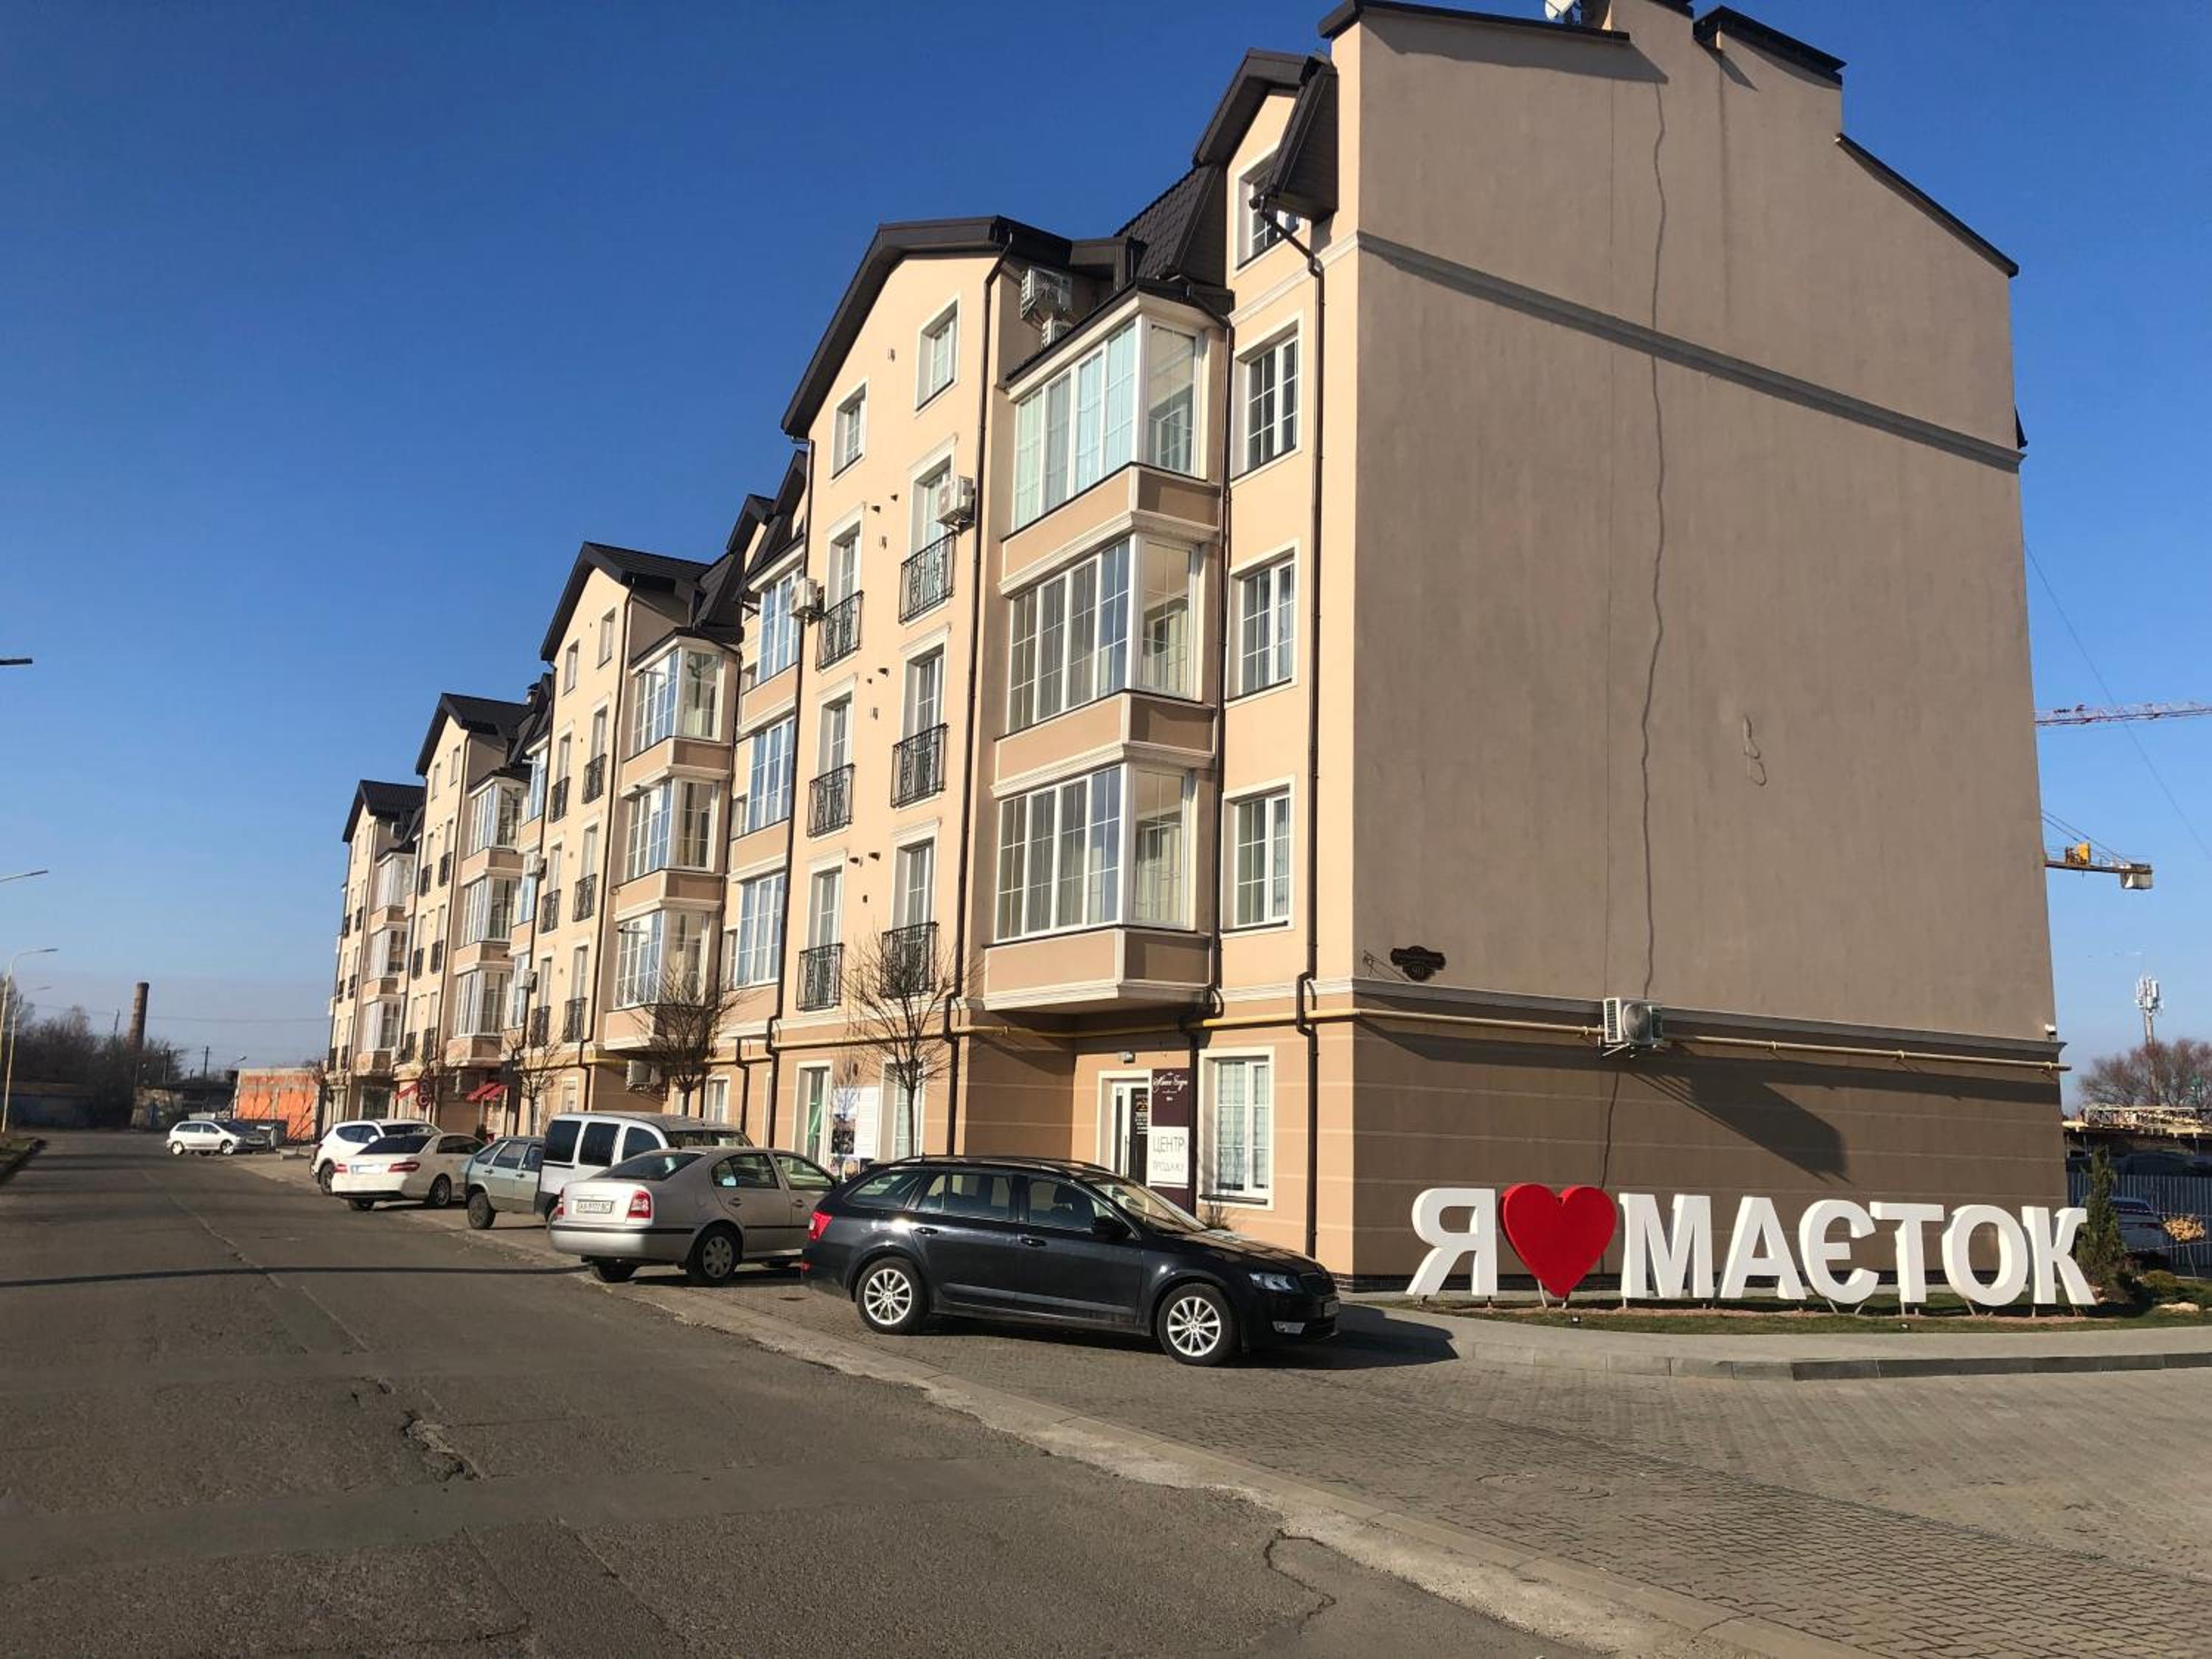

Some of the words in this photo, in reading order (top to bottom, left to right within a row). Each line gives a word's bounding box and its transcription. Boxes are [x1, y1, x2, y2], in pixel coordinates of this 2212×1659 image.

[1152, 1135, 1185, 1154] ЦЕНТР
[1405, 1188, 1497, 1295] Я
[1618, 1193, 2097, 1306] МАЄТОК
